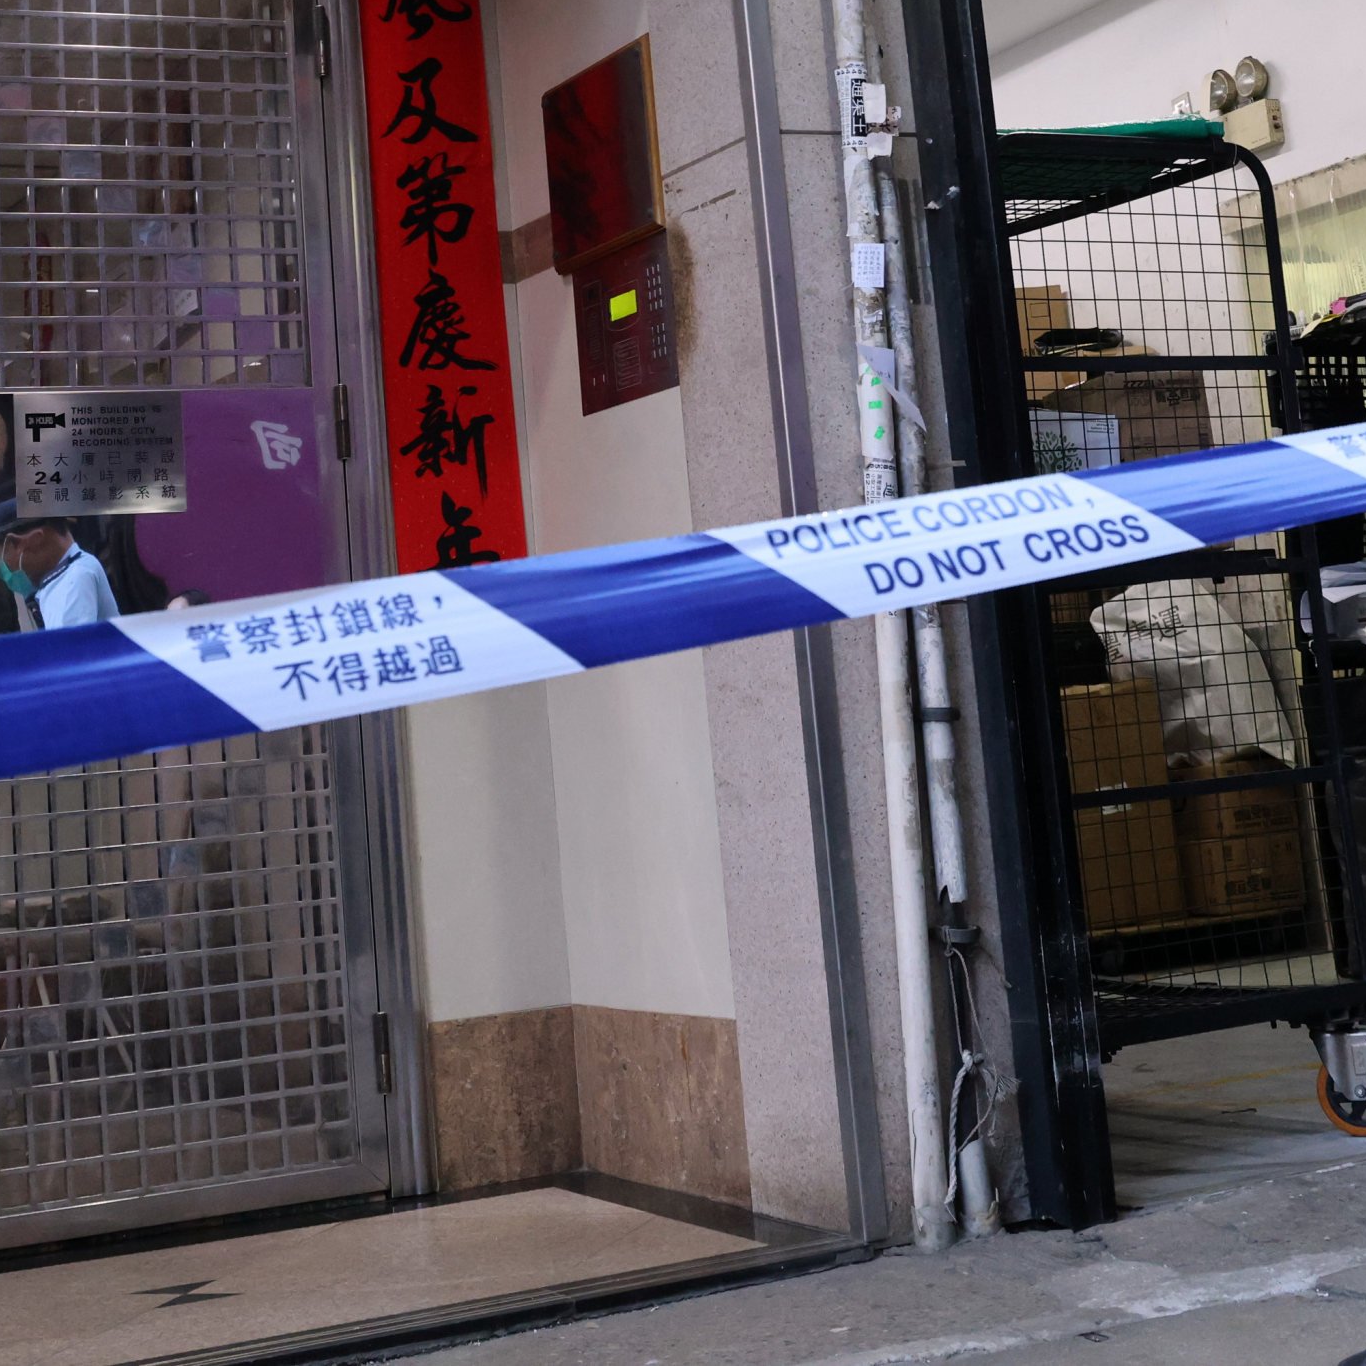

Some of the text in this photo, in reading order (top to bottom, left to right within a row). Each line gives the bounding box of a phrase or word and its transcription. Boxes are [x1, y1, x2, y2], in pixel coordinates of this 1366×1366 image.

[71, 406, 93, 415] THIS
[99, 405, 146, 414] BUILDING
[71, 415, 146, 425] MONITORED BY
[71, 426, 156, 436] 24 HOURS CCTV
[72, 438, 130, 447] RECORDING
[764, 511, 911, 562] POLICE
[867, 513, 1151, 596] DO NOT CROSS
[279, 641, 466, 704] 不得越過
